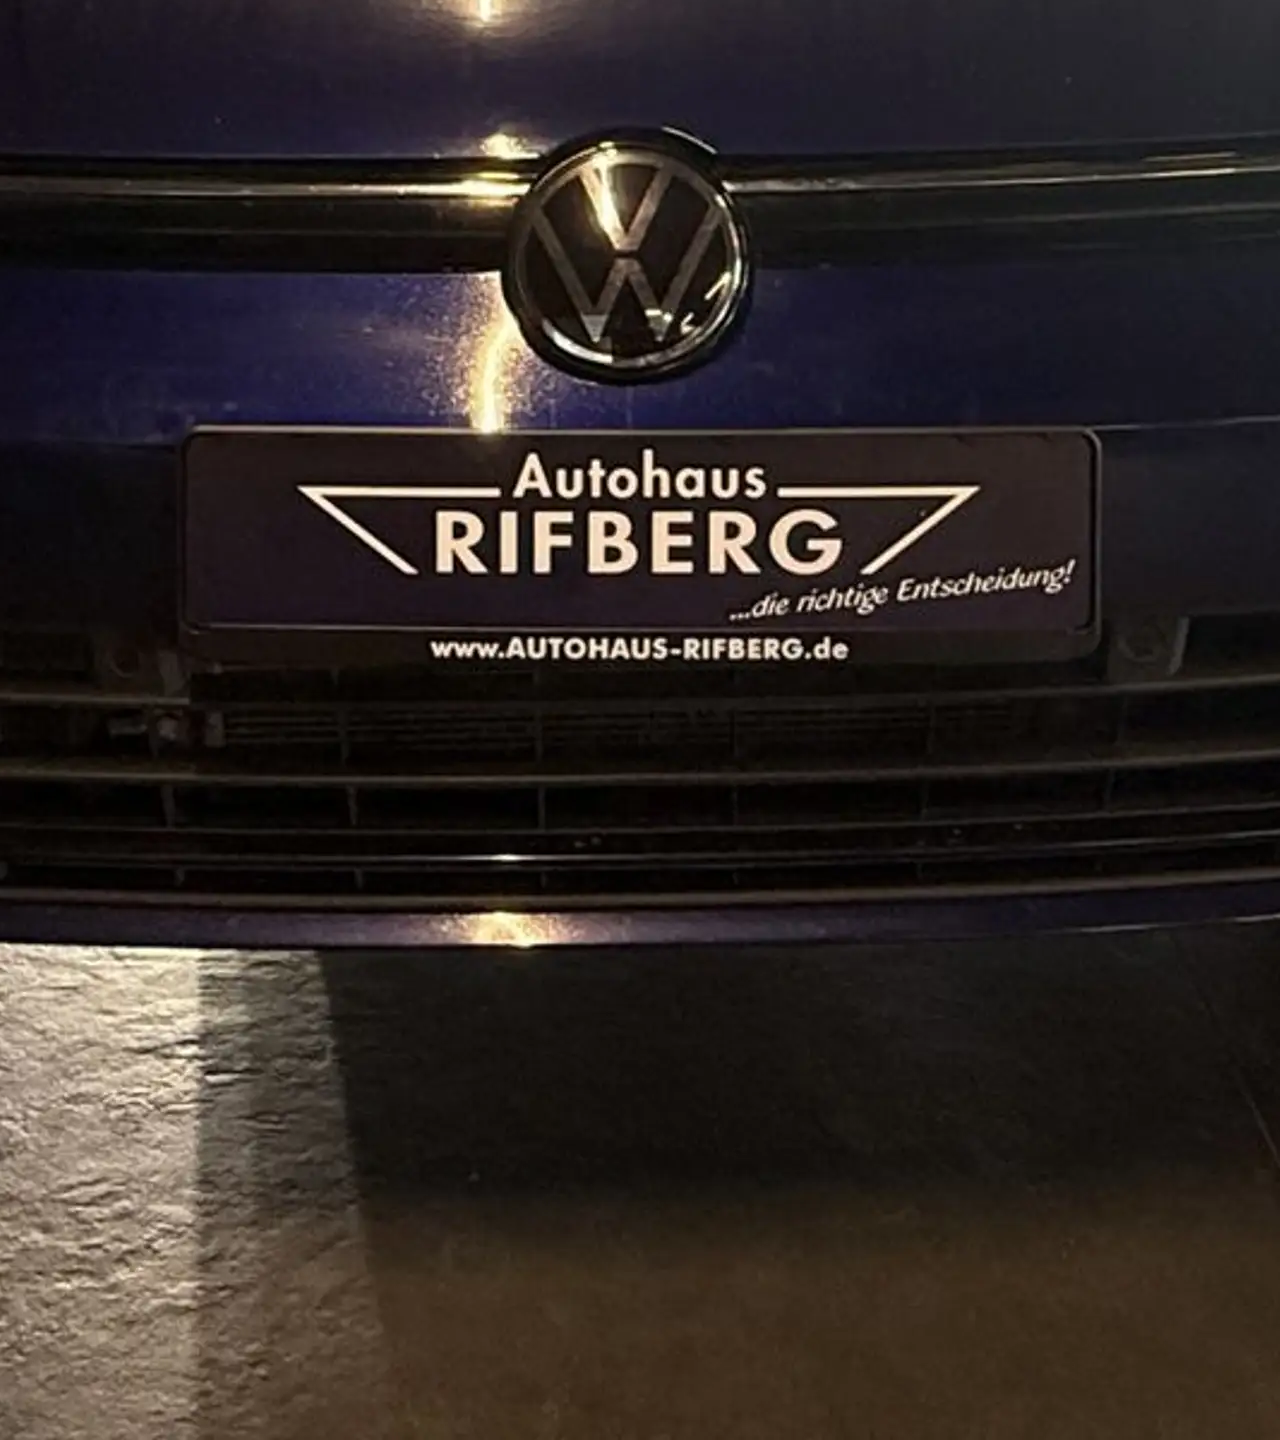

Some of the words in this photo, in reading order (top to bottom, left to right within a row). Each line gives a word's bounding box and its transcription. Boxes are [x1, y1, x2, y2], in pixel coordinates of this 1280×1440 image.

[512, 448, 767, 499] Autohaus
[435, 509, 843, 576] RIFBERG
[796, 582, 889, 615] richtige
[896, 559, 1077, 594] Entscheidung!
[430, 636, 849, 660] www.AUTOHAUS-RIFBERG.de
